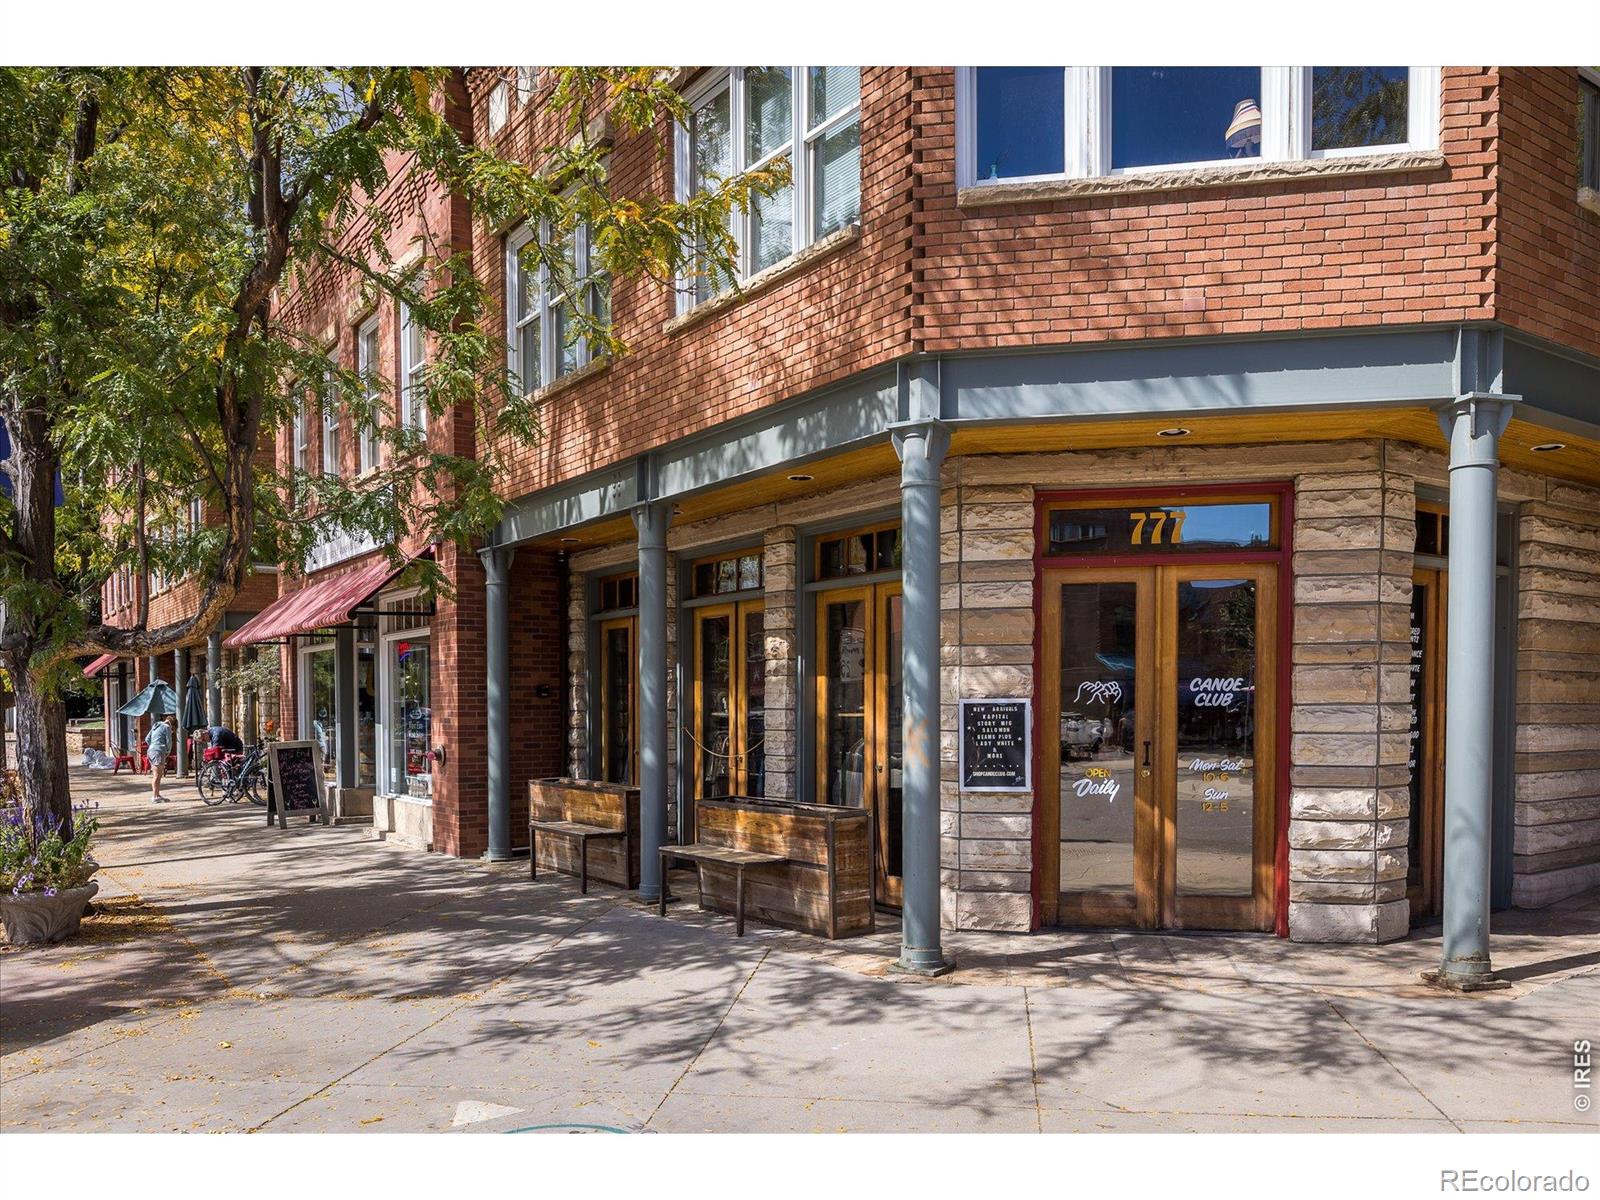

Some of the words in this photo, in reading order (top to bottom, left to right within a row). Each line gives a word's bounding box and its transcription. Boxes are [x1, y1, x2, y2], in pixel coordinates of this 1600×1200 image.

[1130, 512, 1187, 545] 777
[1190, 677, 1244, 692] CANOE
[1194, 692, 1234, 707] CLUB
[1085, 768, 1112, 778] OPEN
[1072, 777, 1121, 803] Daily
[1204, 788, 1229, 800] Sun
